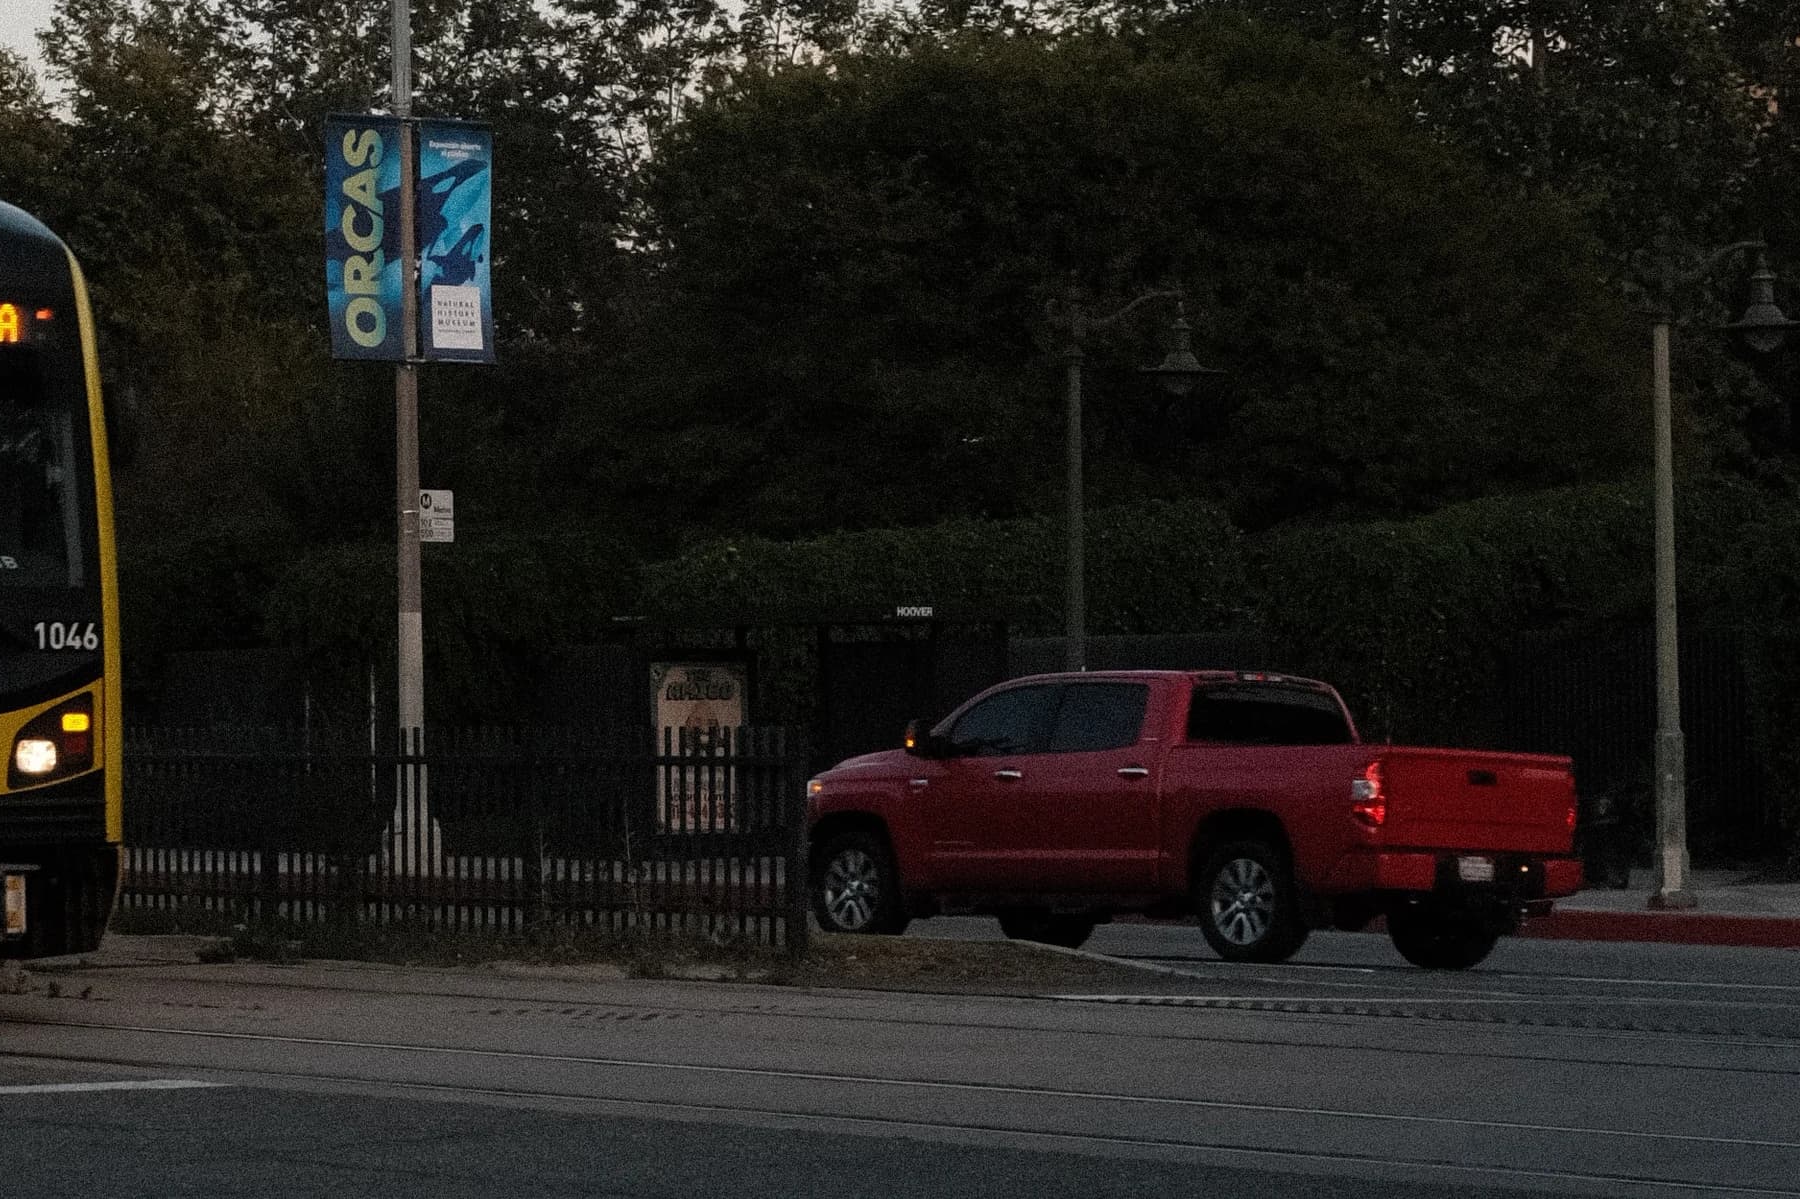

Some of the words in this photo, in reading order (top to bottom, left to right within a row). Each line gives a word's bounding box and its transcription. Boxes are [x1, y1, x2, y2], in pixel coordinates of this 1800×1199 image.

[342, 129, 388, 348] ORCAS
[437, 300, 474, 309] NATURAL
[437, 309, 475, 318] HISTORY
[437, 319, 476, 327] MUSEUM
[896, 606, 934, 618] HOOVER
[34, 621, 100, 650] 1046
